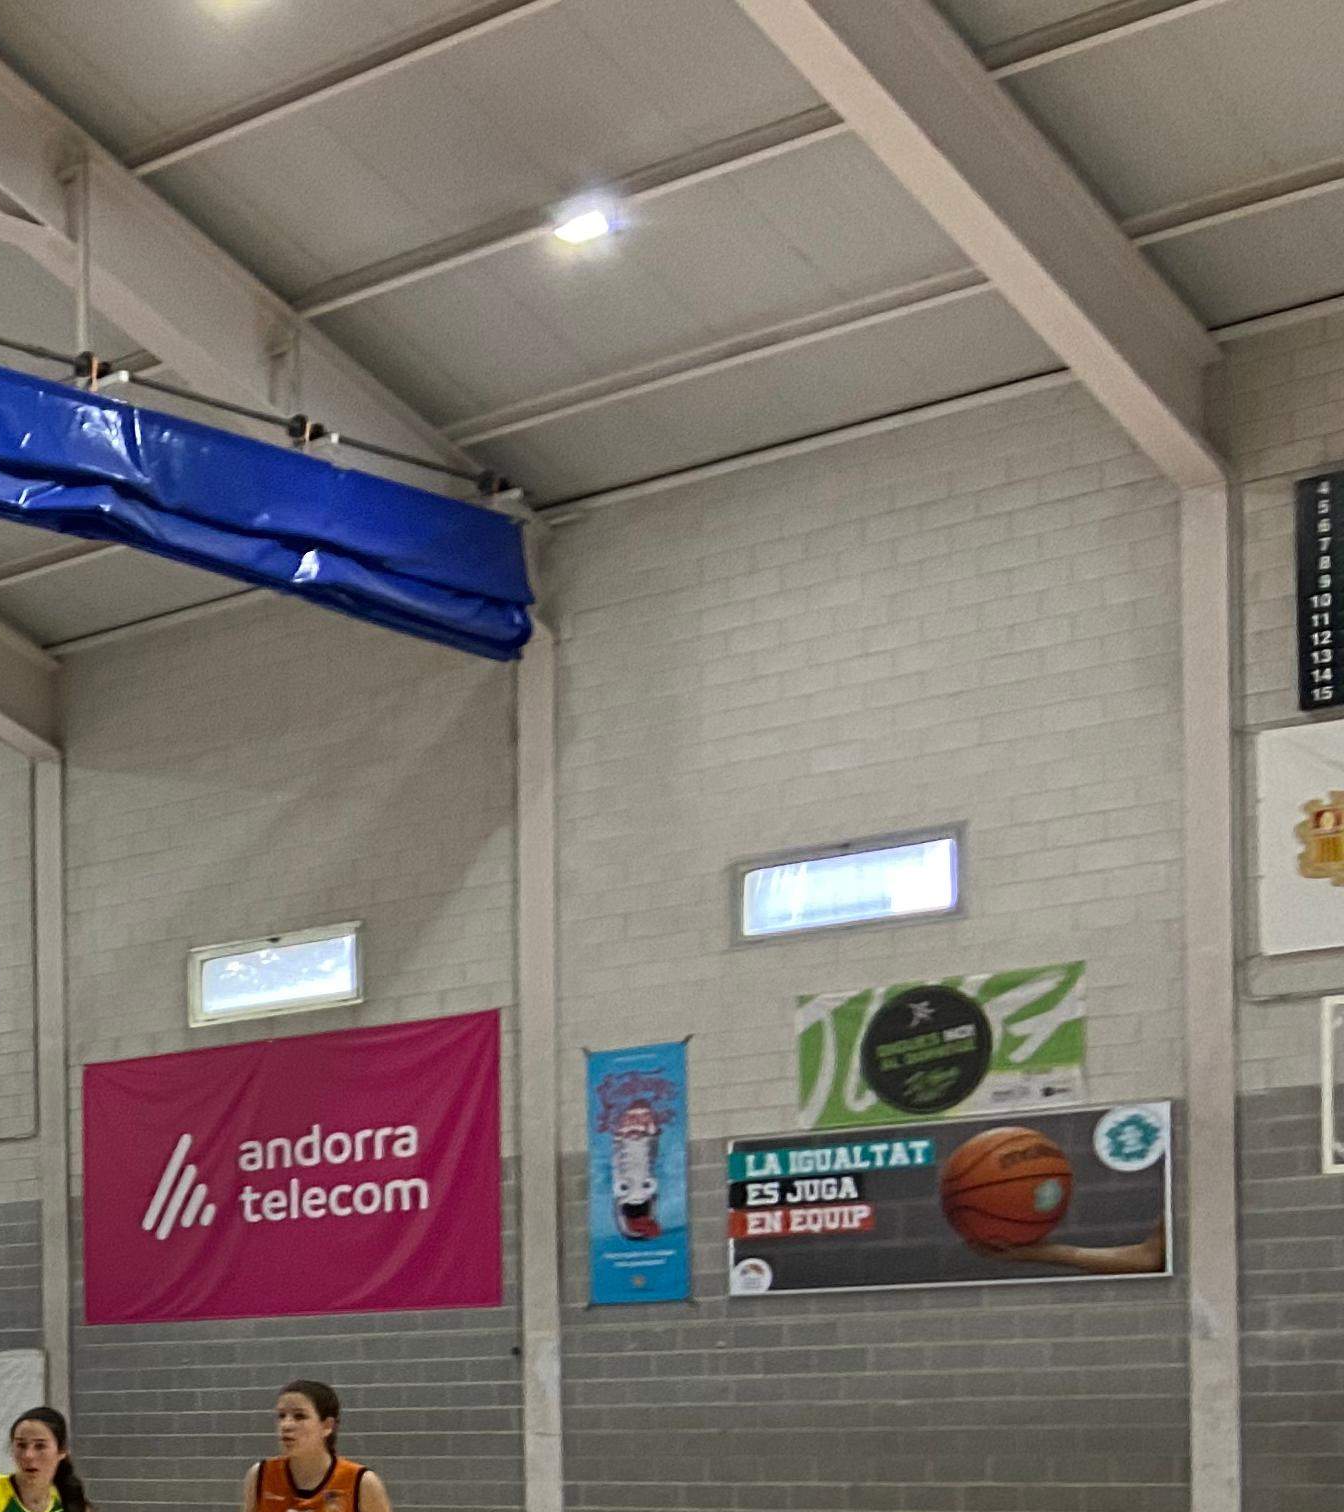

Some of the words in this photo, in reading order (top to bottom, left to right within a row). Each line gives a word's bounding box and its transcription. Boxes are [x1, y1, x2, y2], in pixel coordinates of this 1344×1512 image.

[1317, 481, 1330, 494] 4
[1318, 500, 1329, 514] 5
[1318, 518, 1330, 532] 6
[1318, 537, 1330, 551] 7
[1318, 555, 1331, 570] 8
[1318, 574, 1331, 588] 9
[1310, 593, 1332, 608] 10
[1311, 613, 1330, 626] 11
[1311, 631, 1332, 645] 12
[1311, 650, 1332, 664] 13
[1312, 668, 1332, 682] 14
[1312, 686, 1333, 701] 15
[238, 1123, 419, 1173] andorra
[745, 1154, 782, 1178] LA
[788, 1140, 930, 1173] IGUALTAT
[746, 1182, 780, 1205] ES
[786, 1177, 859, 1202] JUGA
[240, 1176, 429, 1223] telecom
[746, 1211, 782, 1234] EN
[789, 1205, 872, 1233] EQUIP
